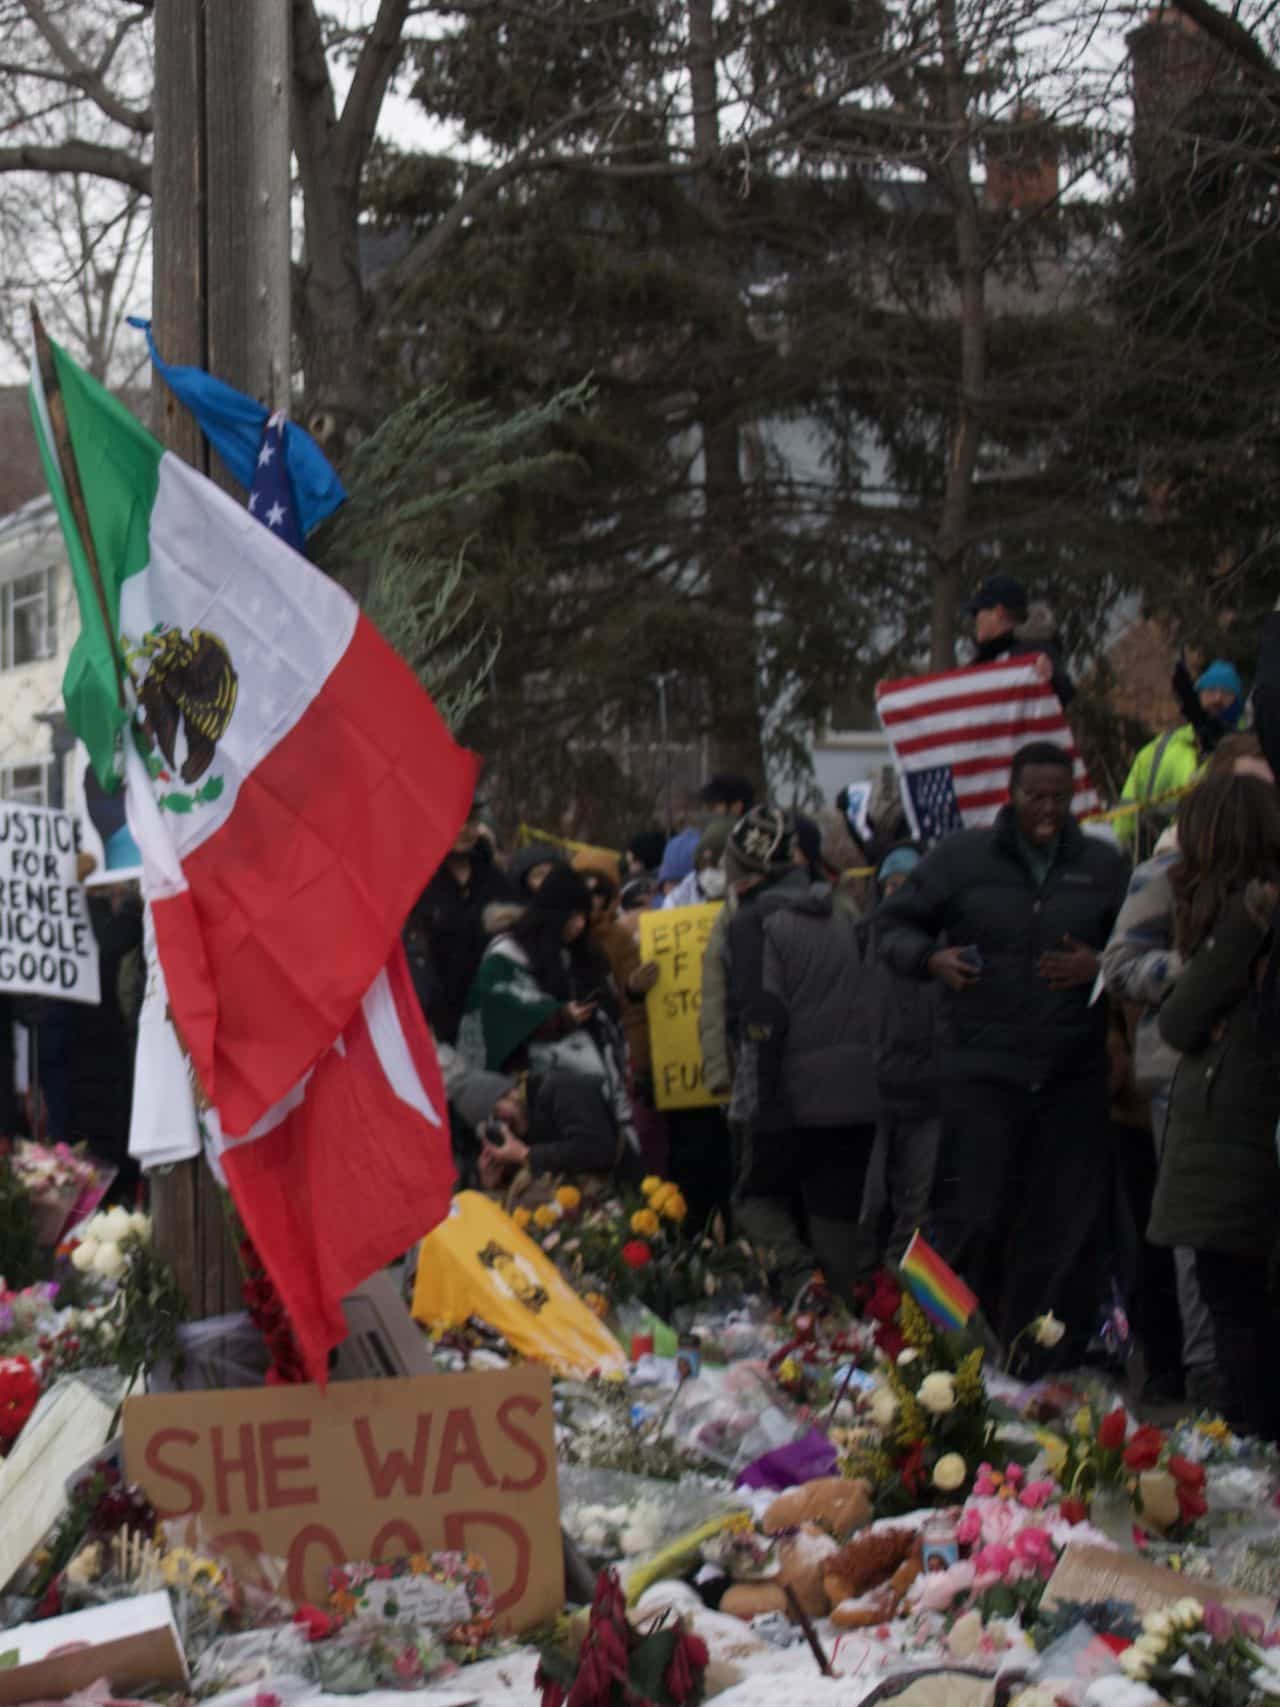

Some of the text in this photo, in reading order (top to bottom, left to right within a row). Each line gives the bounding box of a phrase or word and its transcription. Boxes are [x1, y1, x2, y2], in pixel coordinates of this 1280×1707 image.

[11, 850, 60, 880] FOR
[663, 1062, 704, 1097] FU
[144, 1394, 549, 1522] SHE WAS
